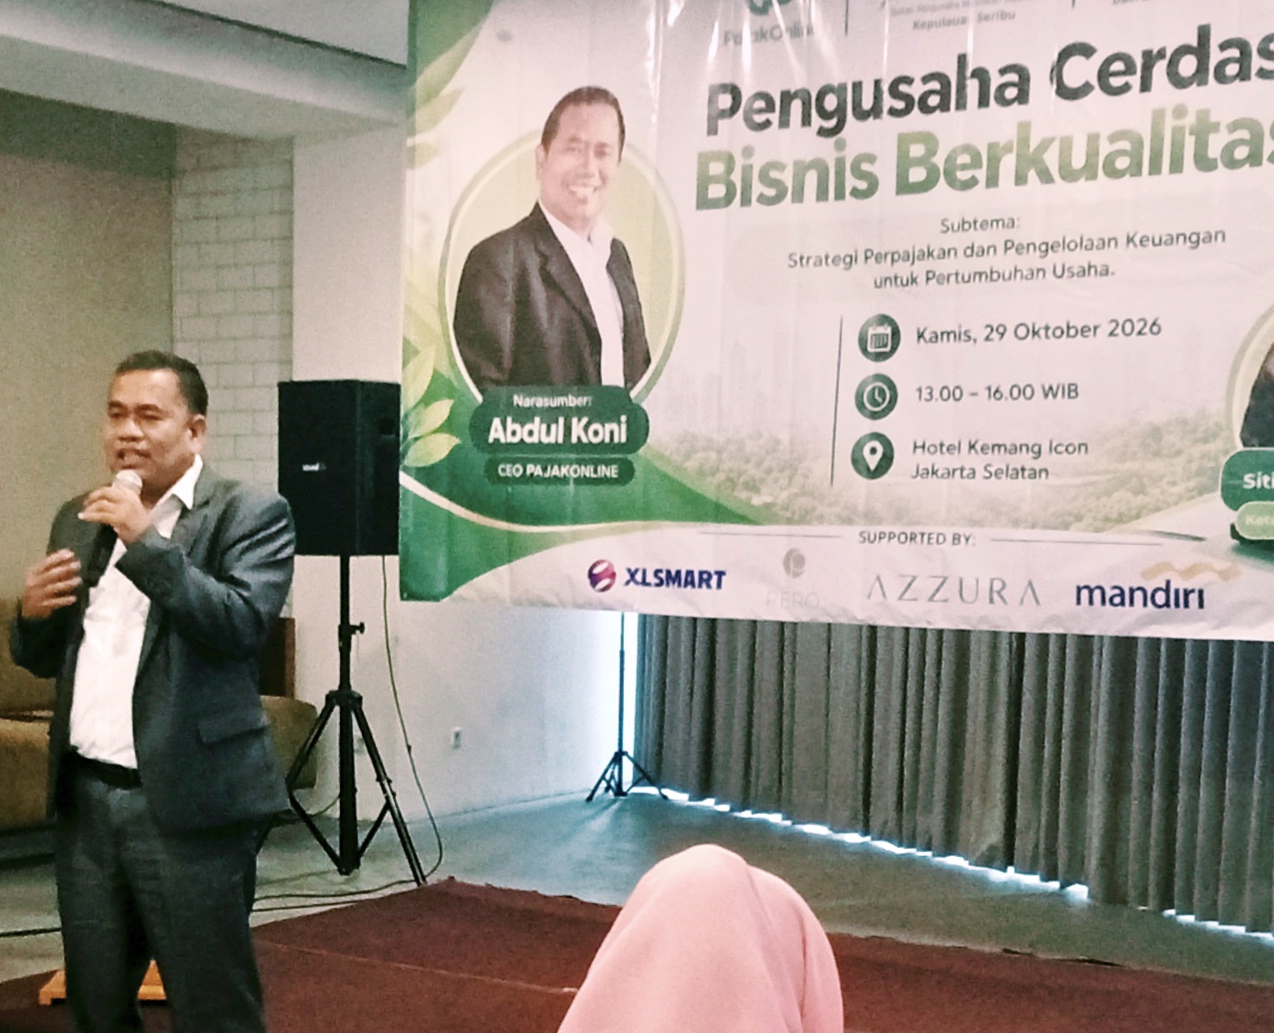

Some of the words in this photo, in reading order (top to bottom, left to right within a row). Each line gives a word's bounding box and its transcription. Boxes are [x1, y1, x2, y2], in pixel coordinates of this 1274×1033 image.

[707, 53, 1031, 138] Pengusaha
[1050, 23, 1274, 101] Cerdas
[696, 137, 879, 211] Bisnis
[895, 103, 1274, 197] Berkualita
[940, 216, 1021, 234] Subtema:
[788, 249, 858, 271] Strategi
[864, 244, 958, 267] Perpajakan
[963, 241, 997, 259] dan
[1003, 234, 1119, 260] Pengelolaan
[1125, 229, 1226, 250] Keuangan
[874, 271, 919, 289] untuk
[925, 265, 1047, 286] Pertumbuhan
[1052, 261, 1116, 280] Usaha.
[916, 324, 978, 345] Kamis,
[983, 323, 1007, 342] 29
[1014, 320, 1101, 341] Oktober
[1107, 317, 1162, 338] 2026
[916, 385, 964, 402] 13.00
[984, 383, 1035, 401] 16.00
[1041, 383, 1079, 400] WIB
[488, 416, 565, 444] Abdul
[571, 415, 628, 444] Koni
[912, 439, 962, 455] Hotel
[968, 439, 1042, 460] Kemang
[1048, 438, 1089, 456] Icon
[498, 464, 524, 478] CEO
[526, 464, 619, 478] PAJAKONLINE
[911, 463, 976, 480] Jakarta
[982, 463, 1050, 480] Selatan
[858, 530, 947, 546] SUPPORTED
[623, 568, 726, 591] XLSMART
[866, 574, 1042, 607] AZZURA
